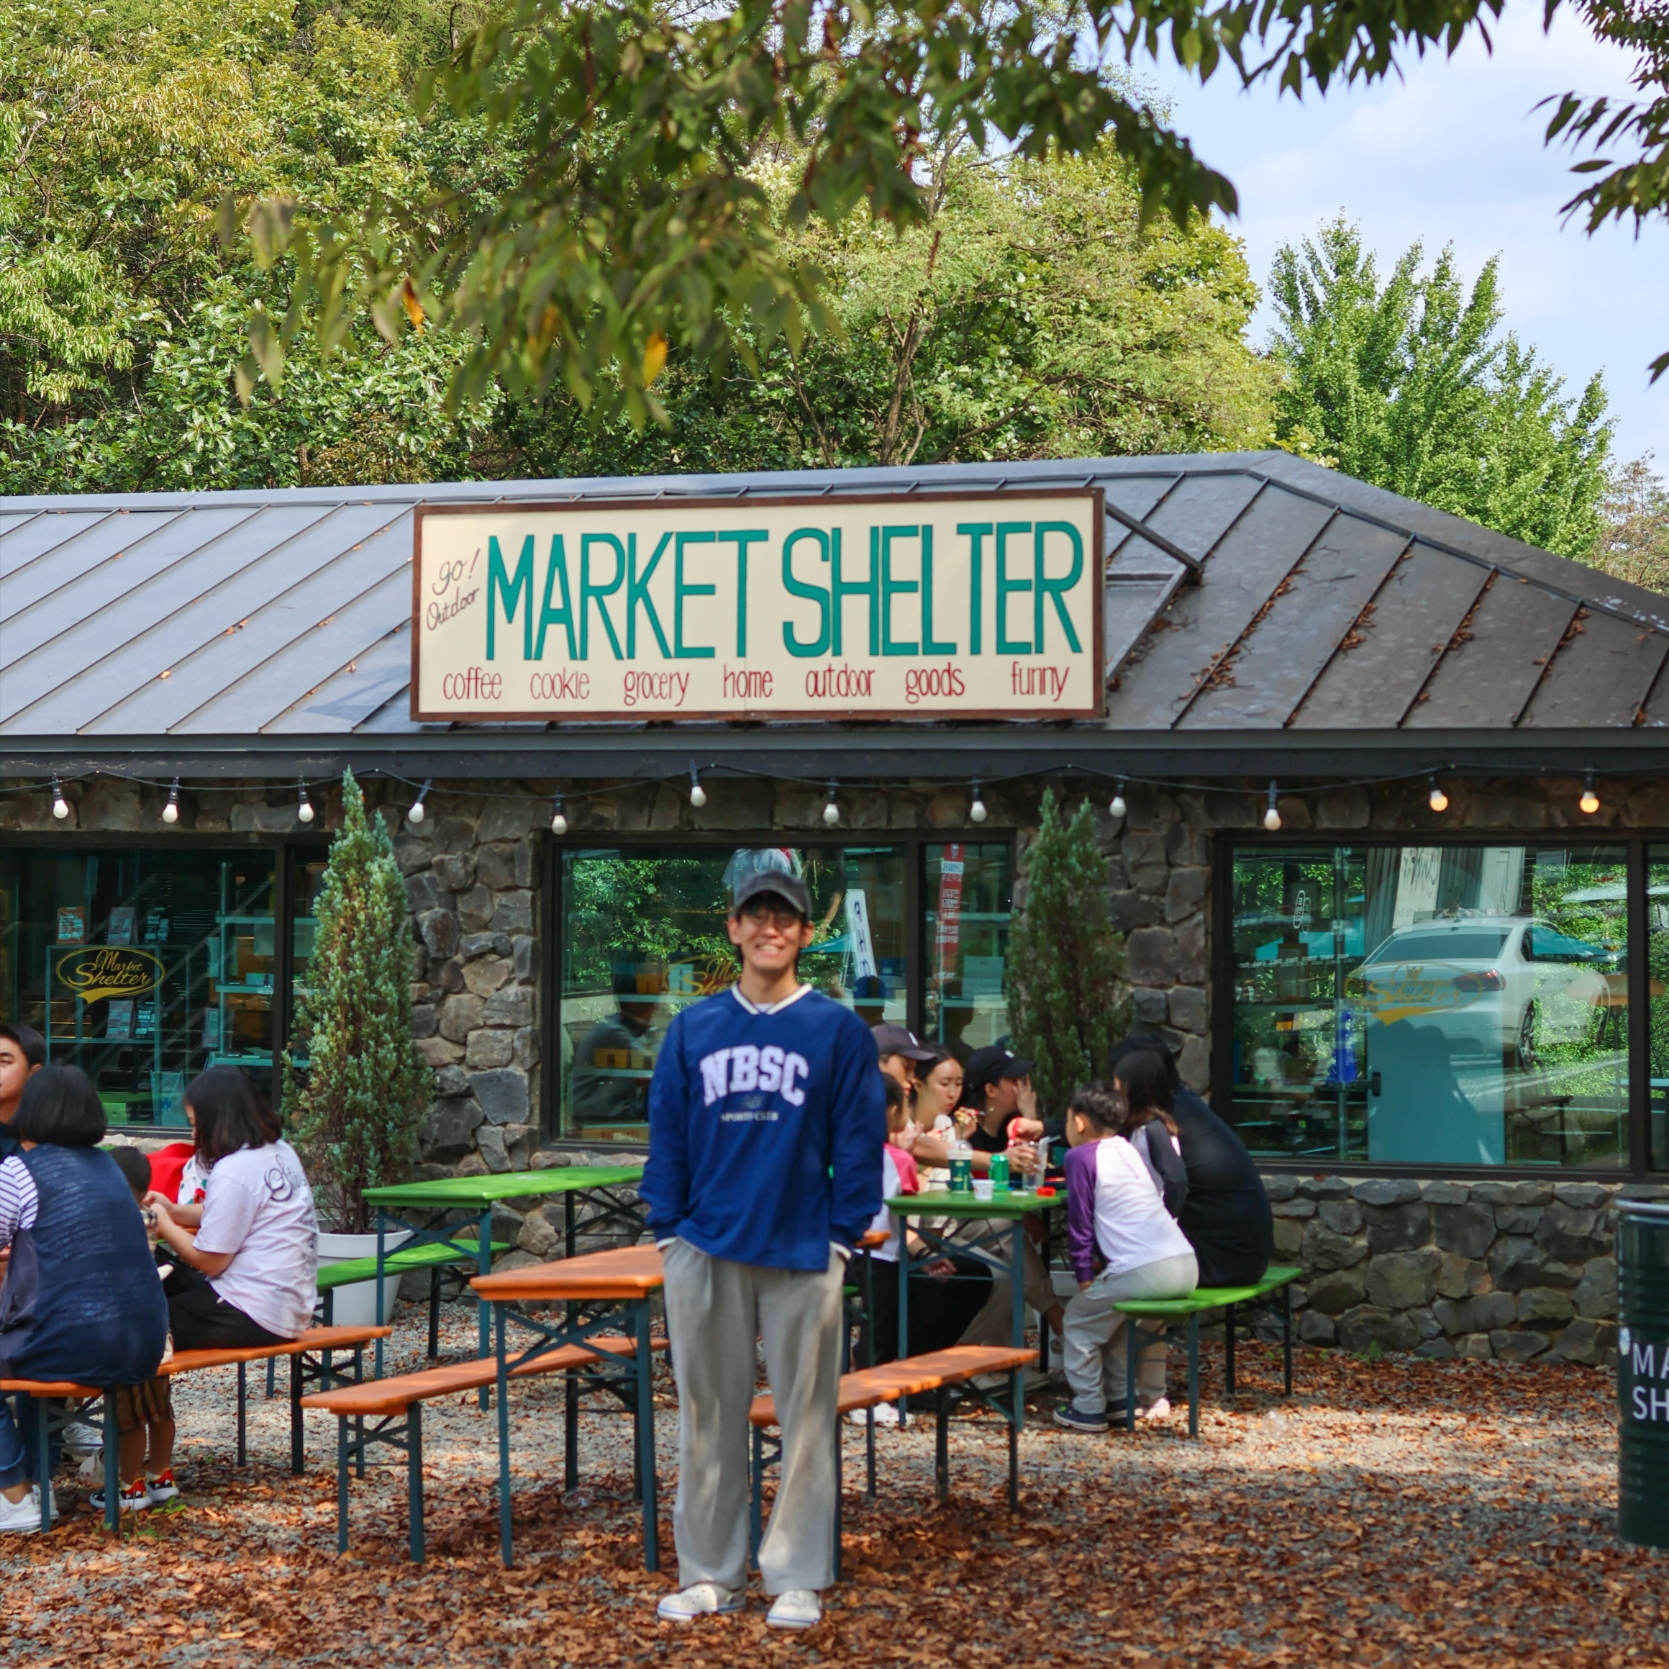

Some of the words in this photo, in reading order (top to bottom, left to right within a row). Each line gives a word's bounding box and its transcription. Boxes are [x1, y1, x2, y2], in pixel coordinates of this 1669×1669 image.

[431, 548, 481, 596] go!
[486, 529, 769, 661] MARKET
[782, 520, 1084, 657] SHELTER
[426, 586, 480, 631] Outdoor
[443, 667, 502, 700] coffee
[530, 667, 590, 700] cookie
[623, 670, 690, 707] grocery
[723, 664, 773, 698] home
[905, 662, 965, 704] goods
[1011, 661, 1070, 702] funny
[67, 962, 151, 987] Shelter
[95, 949, 144, 971] Market
[699, 1044, 809, 1107] NBSC
